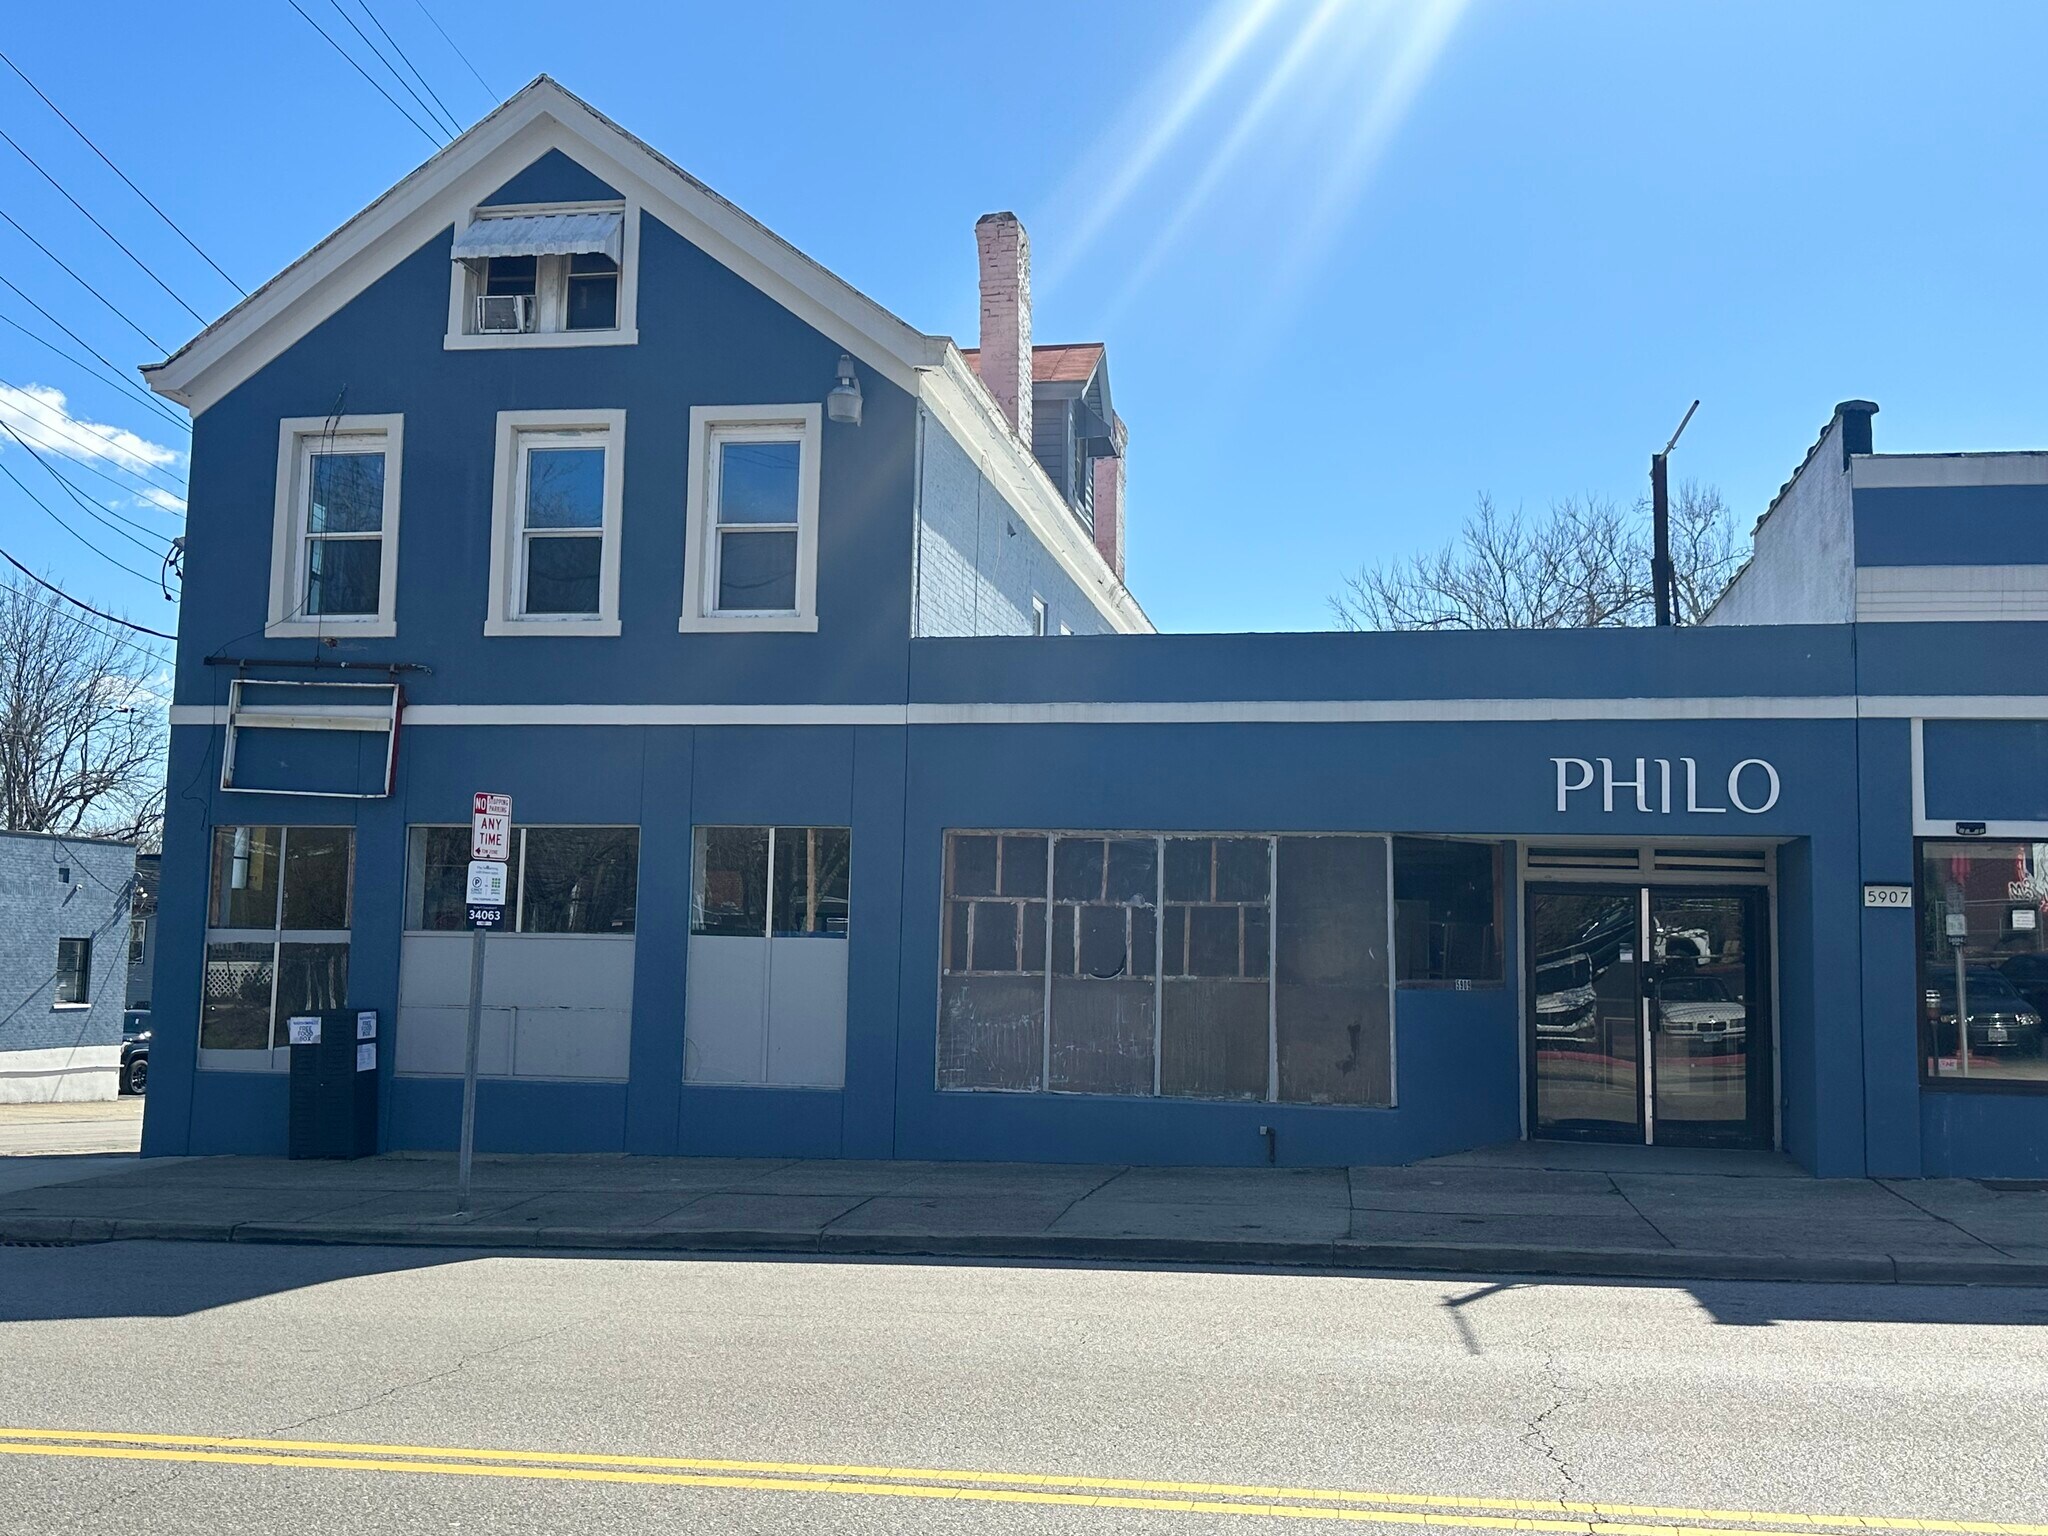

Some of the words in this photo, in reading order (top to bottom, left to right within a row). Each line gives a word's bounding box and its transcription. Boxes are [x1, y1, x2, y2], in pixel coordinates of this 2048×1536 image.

[1550, 757, 1781, 814] PHILO
[475, 797, 487, 811] NO
[489, 804, 508, 813] PARKING
[481, 817, 502, 830] ANY
[480, 832, 502, 846] TIME
[1868, 890, 1909, 904] 5907
[468, 909, 501, 921] 34063
